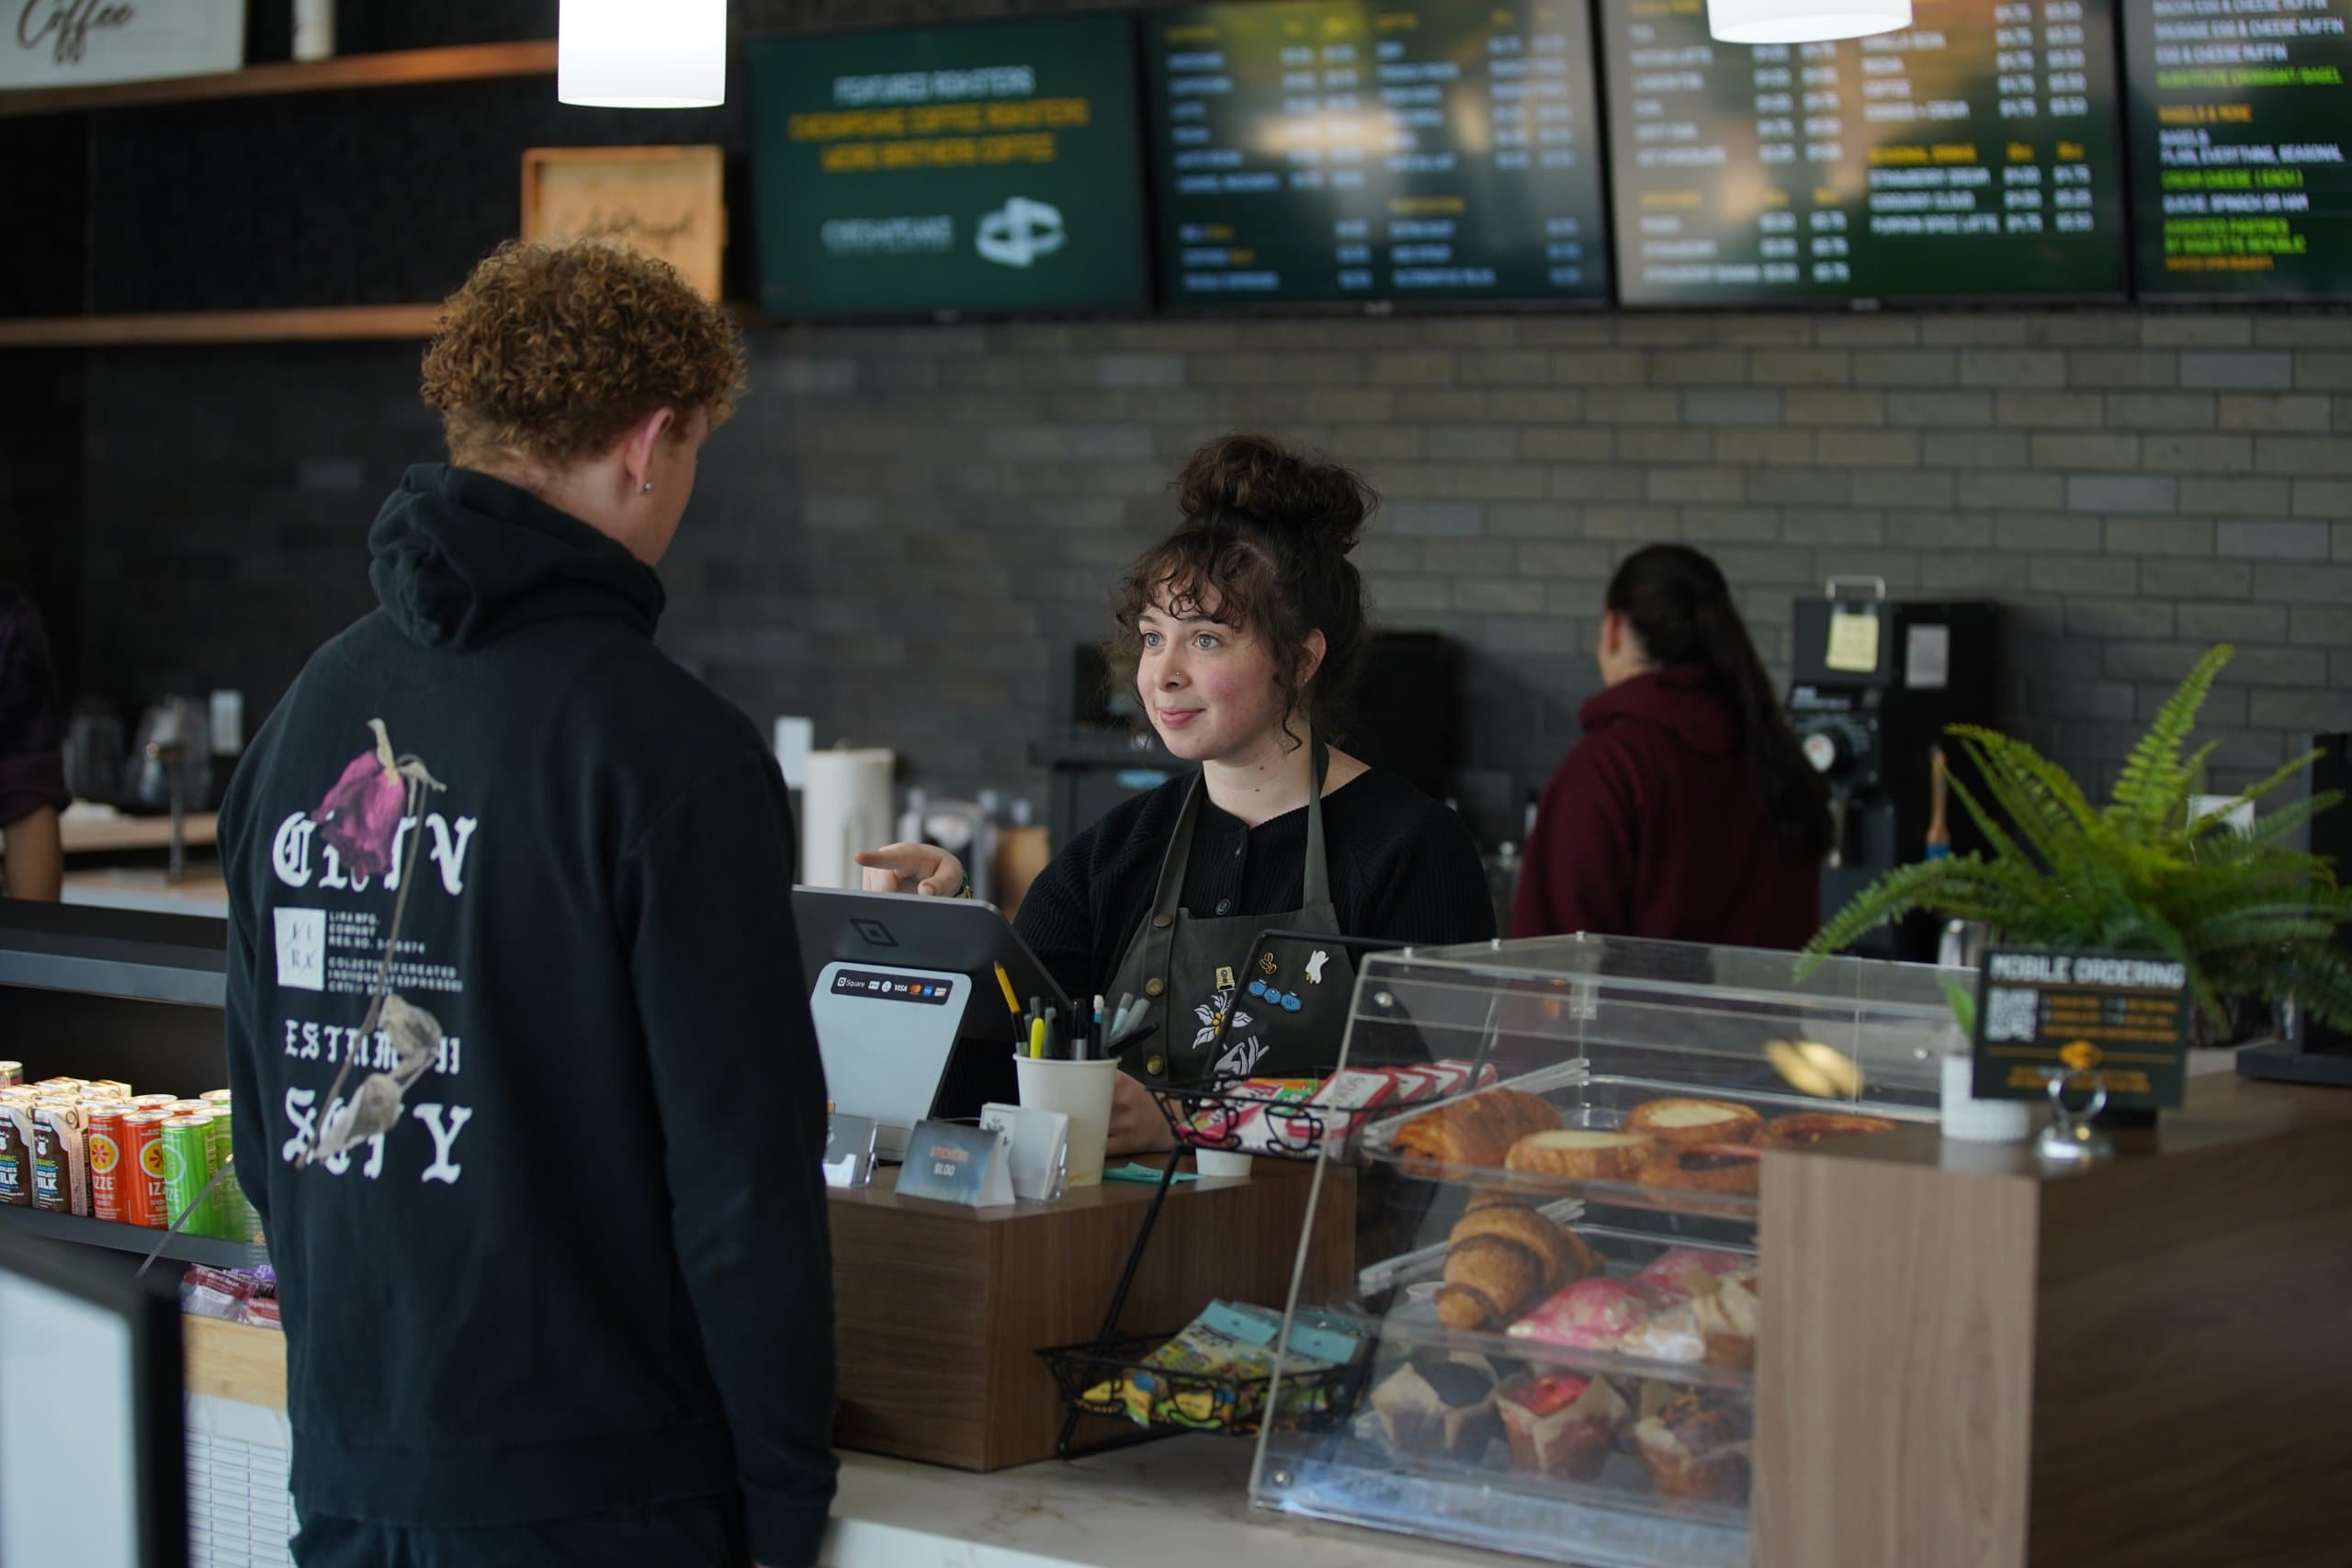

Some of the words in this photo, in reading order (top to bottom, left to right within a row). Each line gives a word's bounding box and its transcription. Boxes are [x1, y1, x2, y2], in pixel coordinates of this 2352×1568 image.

[2249, 17, 2299, 38] CHEESE
[2300, 16, 2345, 36] MUFFIN
[2193, 43, 2242, 63] CHEESE
[2243, 42, 2289, 62] MUFFIN
[1989, 953, 2070, 983] MOBILE
[2073, 957, 2186, 989] ORDERING
[845, 978, 865, 987] Square
[894, 984, 908, 992] VISA
